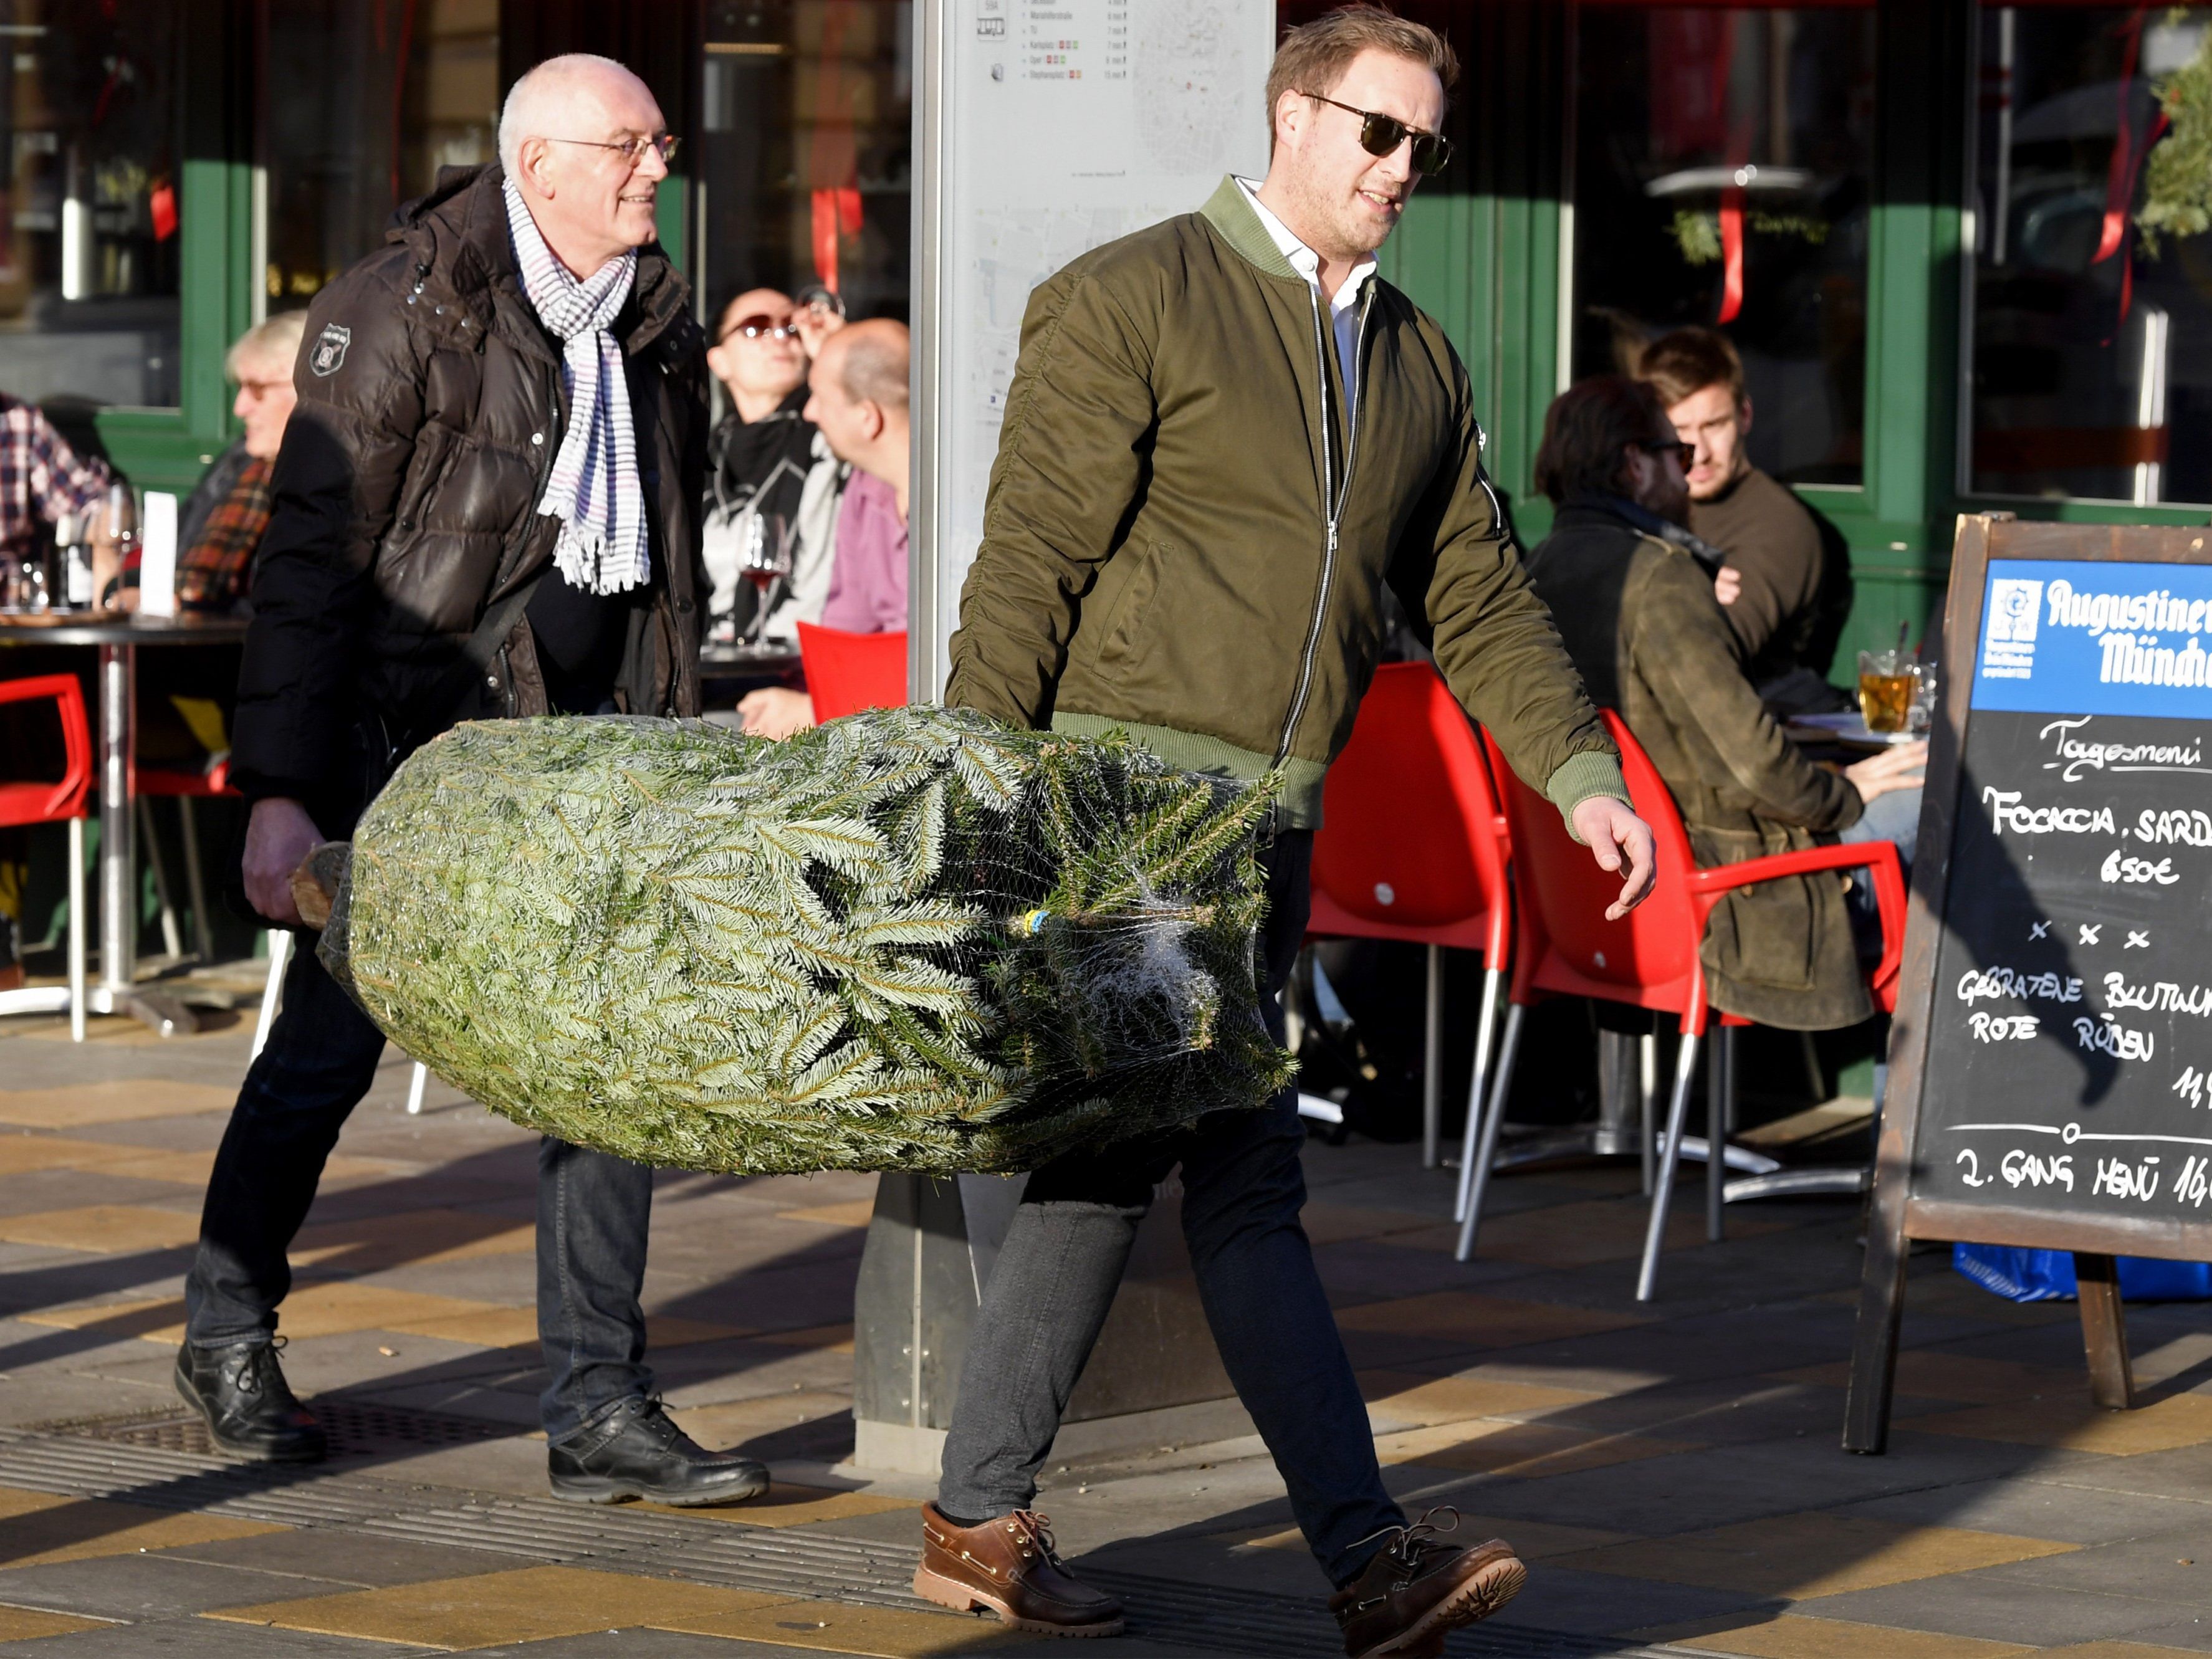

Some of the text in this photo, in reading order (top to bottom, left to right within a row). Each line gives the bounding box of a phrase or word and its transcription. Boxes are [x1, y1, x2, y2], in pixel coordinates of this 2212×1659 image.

[2134, 810, 2212, 847] SARD
[1957, 965, 2084, 1007] GEBRATENE
[1968, 1011, 2154, 1062] ROTE RÜBEN
[1956, 1149, 1994, 1187] 2.
[2001, 1149, 2074, 1193] GANG
[2173, 1155, 2212, 1208] 16,
